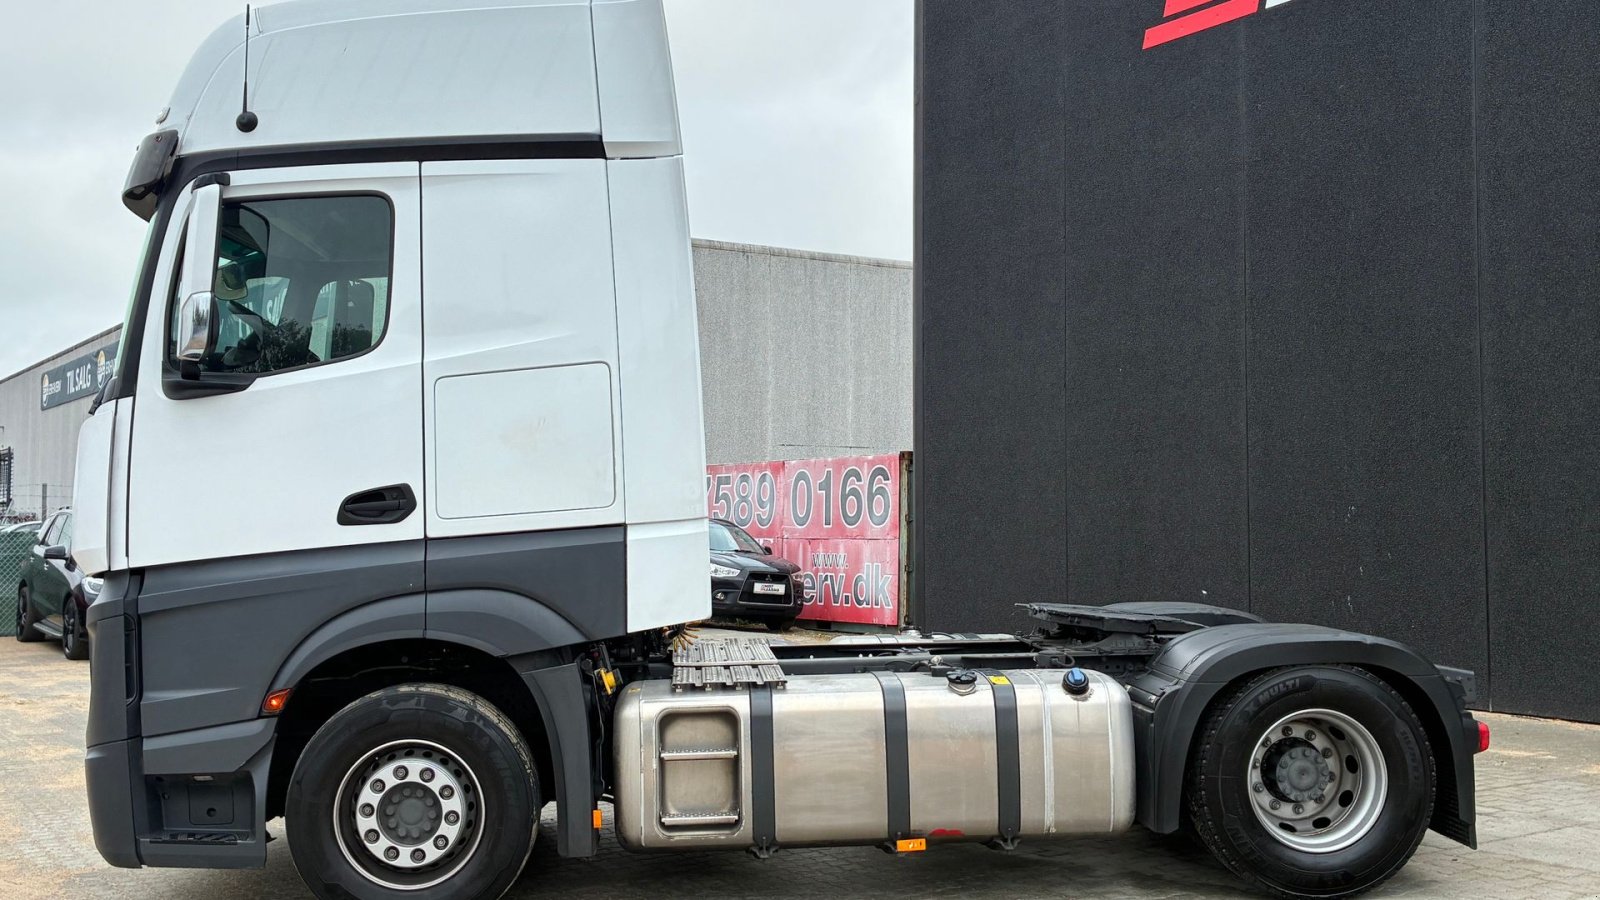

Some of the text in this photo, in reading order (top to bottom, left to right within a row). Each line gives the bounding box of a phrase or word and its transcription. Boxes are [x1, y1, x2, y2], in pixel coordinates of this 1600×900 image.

[66, 370, 75, 394] TIL
[75, 363, 91, 391] SALG
[706, 465, 891, 528] 589 0166
[812, 552, 849, 569] www.
[1258, 678, 1300, 704] MULTI
